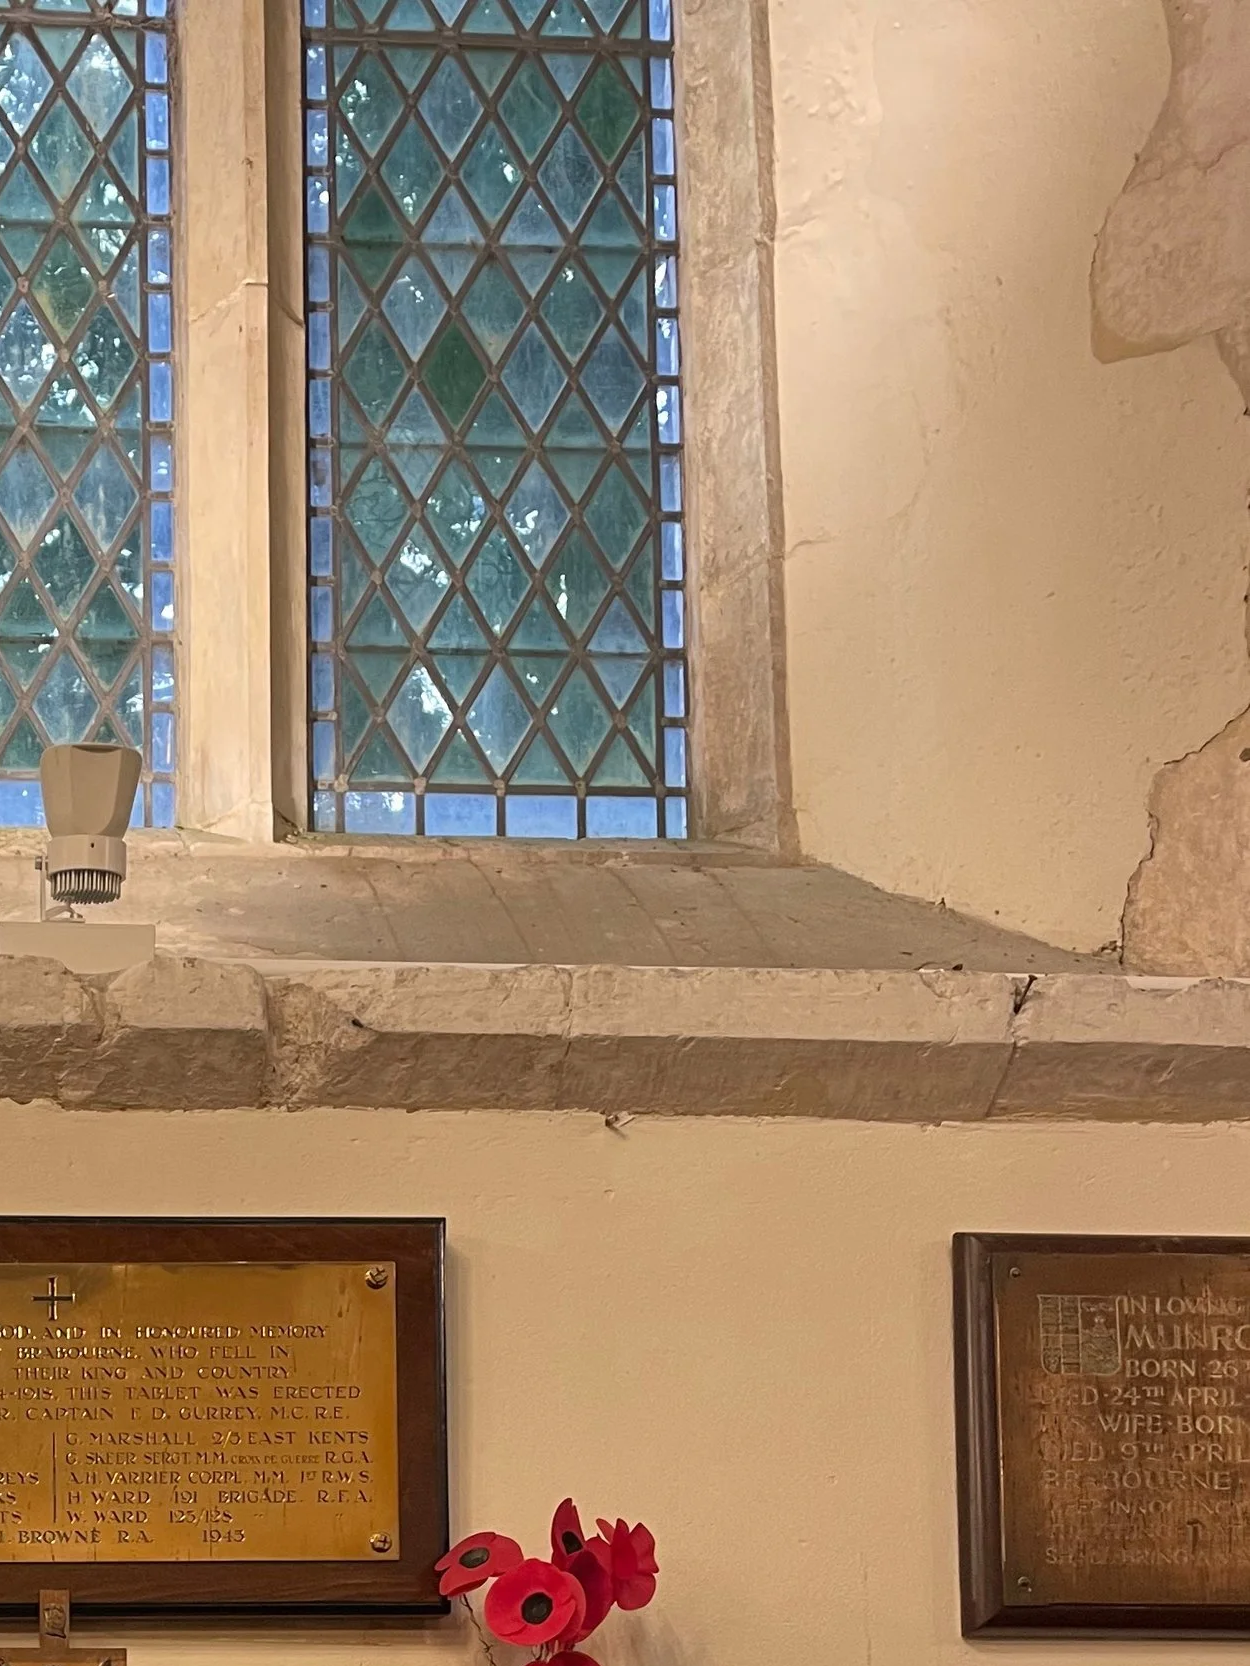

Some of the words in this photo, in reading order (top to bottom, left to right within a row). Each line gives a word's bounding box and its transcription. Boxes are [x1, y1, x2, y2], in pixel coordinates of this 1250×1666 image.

[44, 1324, 86, 1340] AND
[99, 1324, 121, 1340] IN
[135, 1324, 241, 1340] HONOURED
[250, 1324, 327, 1340] MEMORY
[151, 1346, 199, 1361] WHO
[210, 1346, 256, 1361] FELL
[269, 1346, 291, 1361] IN
[12, 1366, 71, 1381] THEIR
[81, 1366, 127, 1381] KING
[142, 1366, 184, 1381] AND
[197, 1366, 291, 1381] COUNTRY
[1124, 1358, 1197, 1378] BORN
[65, 1386, 112, 1401] THIS
[125, 1386, 201, 1401] TABLET
[216, 1386, 259, 1401] WAS
[273, 1386, 362, 1401] ERECTED
[1170, 1386, 1243, 1407] APRIL
[26, 1406, 114, 1421] CAPTAIN
[1099, 1413, 1163, 1434] WIFE
[66, 1431, 85, 1448] G.
[90, 1431, 197, 1448] MARSHALL
[248, 1431, 296, 1448] EAST
[309, 1431, 369, 1448] KENTS
[85, 1451, 137, 1466] SKEER
[231, 1455, 261, 1465] CROIX
[265, 1455, 278, 1465] DE
[281, 1455, 320, 1465] GUERRE
[1171, 1443, 1250, 1463] APRIL
[106, 1470, 181, 1485] VARRIER
[91, 1490, 151, 1505] WARD
[94, 1509, 149, 1526] WARD
[18, 1529, 101, 1545] BROWNE
